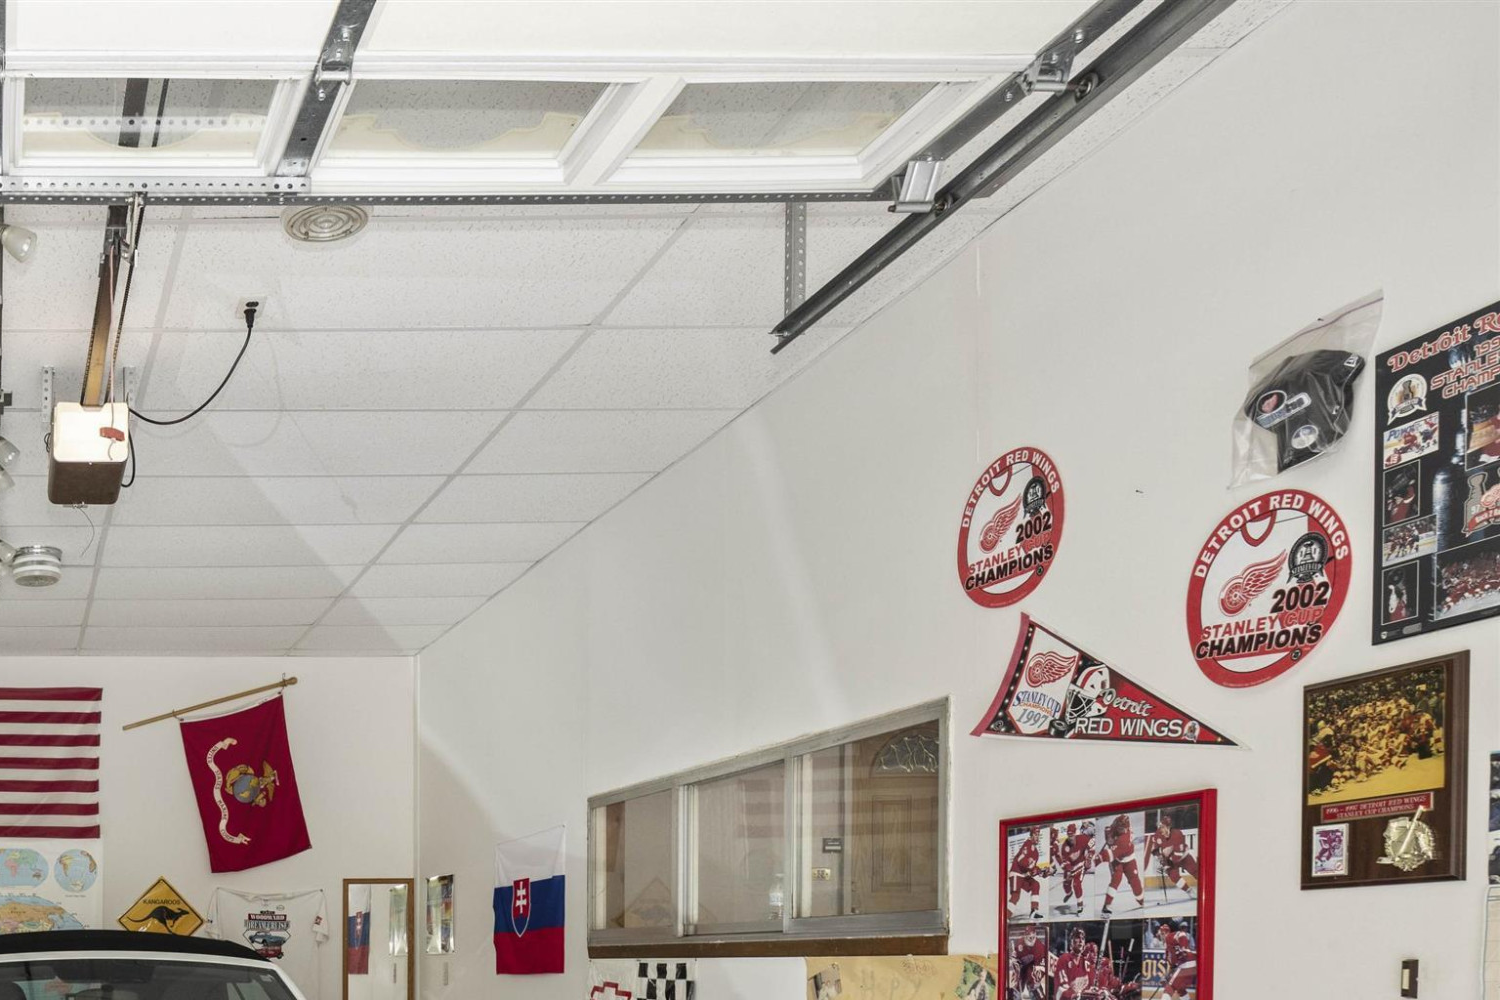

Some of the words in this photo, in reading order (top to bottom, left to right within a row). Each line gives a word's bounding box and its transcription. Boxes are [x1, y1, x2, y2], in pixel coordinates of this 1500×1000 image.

[1387, 324, 1472, 373] Detroit
[1430, 352, 1500, 390] STANLE
[962, 460, 1004, 528] DETROIT
[1006, 450, 1029, 466] RED
[1032, 451, 1060, 493] WINGS
[1016, 511, 1052, 545] 2002
[1194, 501, 1262, 578] DETROIT
[1269, 494, 1304, 510] RED
[1308, 499, 1349, 560] WINGS
[965, 544, 1054, 591] CHAMPIONS
[969, 544, 1023, 575] STANLEY
[1025, 533, 1051, 549] CUP
[1270, 581, 1330, 613] 2002
[1202, 614, 1280, 640] STANLEY
[1284, 607, 1325, 627] CUP
[1195, 624, 1322, 659] CHAMPIONS
[1012, 690, 1049, 710] STANLEY
[1049, 695, 1062, 717] CUP
[1015, 710, 1049, 729] 1997
[1100, 688, 1156, 717] Detroit
[1075, 717, 1113, 735] RED
[1120, 719, 1183, 738] WINGS
